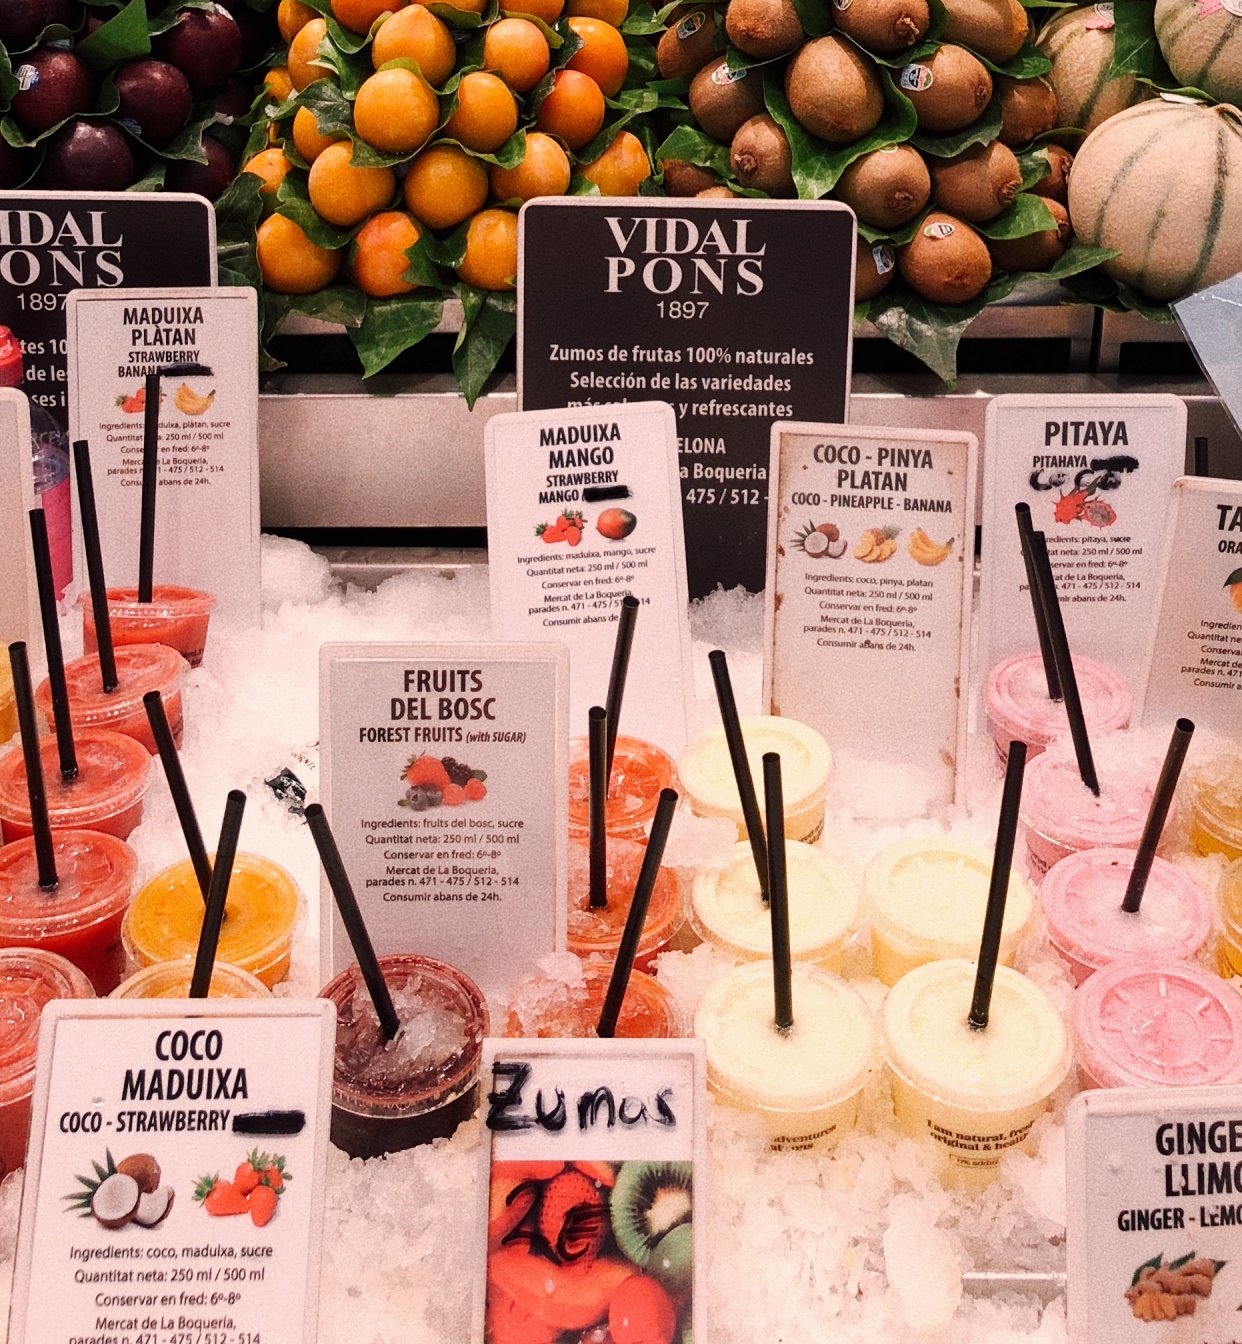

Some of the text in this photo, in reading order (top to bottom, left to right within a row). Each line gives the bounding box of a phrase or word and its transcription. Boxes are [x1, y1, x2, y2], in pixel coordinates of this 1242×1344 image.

[604, 216, 767, 257] VIDAL
[604, 256, 765, 296] PONS
[16, 292, 66, 311] 1897
[656, 301, 710, 319] 1897
[123, 307, 204, 325] MADUIXA
[131, 325, 196, 346] PLÀTAN
[128, 350, 200, 363] STRAWBERRY
[549, 344, 814, 365] Zumos de frutas 100% naturales
[26, 365, 68, 381] de le
[570, 371, 791, 392] Selección de las variedades
[679, 400, 793, 418] y refrescantes
[540, 423, 621, 446] MADUIXA
[1044, 421, 1128, 447] PITAYA
[549, 446, 614, 469] MANGO
[813, 444, 861, 465] COCO
[878, 447, 933, 469] PINYA
[1033, 455, 1087, 468] PITAHAYA
[546, 470, 619, 488] STRAWBERRY
[693, 463, 766, 480] Boqueria
[838, 469, 908, 492] PLATAN
[539, 490, 579, 504] MANGO
[686, 488, 716, 505] 475
[731, 489, 759, 505] 512
[791, 492, 820, 506] COCO
[831, 494, 894, 510] PINEAPPLE
[904, 498, 953, 513] BANANA
[1082, 536, 1108, 544] pitaya,
[517, 554, 564, 565] Ingredients:
[604, 549, 633, 558] mango,
[805, 573, 933, 588] Ingredients: coco, pinya, platan
[403, 670, 483, 693] FRUITS
[391, 697, 496, 721] DEL BOSC
[359, 727, 527, 744] FOREST FRUITS (with SUGAR)
[361, 819, 524, 830] Ingredients: fruits del bosc, sucre
[365, 834, 413, 845] Quantitat
[416, 835, 441, 844] neta:
[443, 834, 461, 844] 250
[464, 834, 476, 844] ml
[486, 834, 504, 844] 500
[507, 834, 520, 844] ml
[384, 850, 434, 859] Conservar
[452, 850, 474, 859] fred:
[386, 865, 499, 878] Mercat de La Boqueria,
[383, 892, 502, 902] Consumir abans de 24h.
[155, 1029, 223, 1062] COCO
[121, 1068, 248, 1101] MADUIXA
[59, 1111, 102, 1133] COCO
[116, 1109, 231, 1132] STRAWBERRY
[930, 1131, 980, 1151] original
[982, 1143, 992, 1151] &
[934, 1125, 952, 1137] am
[956, 1133, 1007, 1142] natural,
[1118, 1207, 1185, 1232] GINGER
[69, 1244, 273, 1262] Ingredients: coco, maduixa, sucre
[74, 1269, 133, 1283] Quantitat
[137, 1269, 168, 1282] neta:
[171, 1268, 194, 1282] 250
[196, 1267, 212, 1281] ml
[223, 1268, 247, 1281] 500
[250, 1267, 265, 1281] ml
